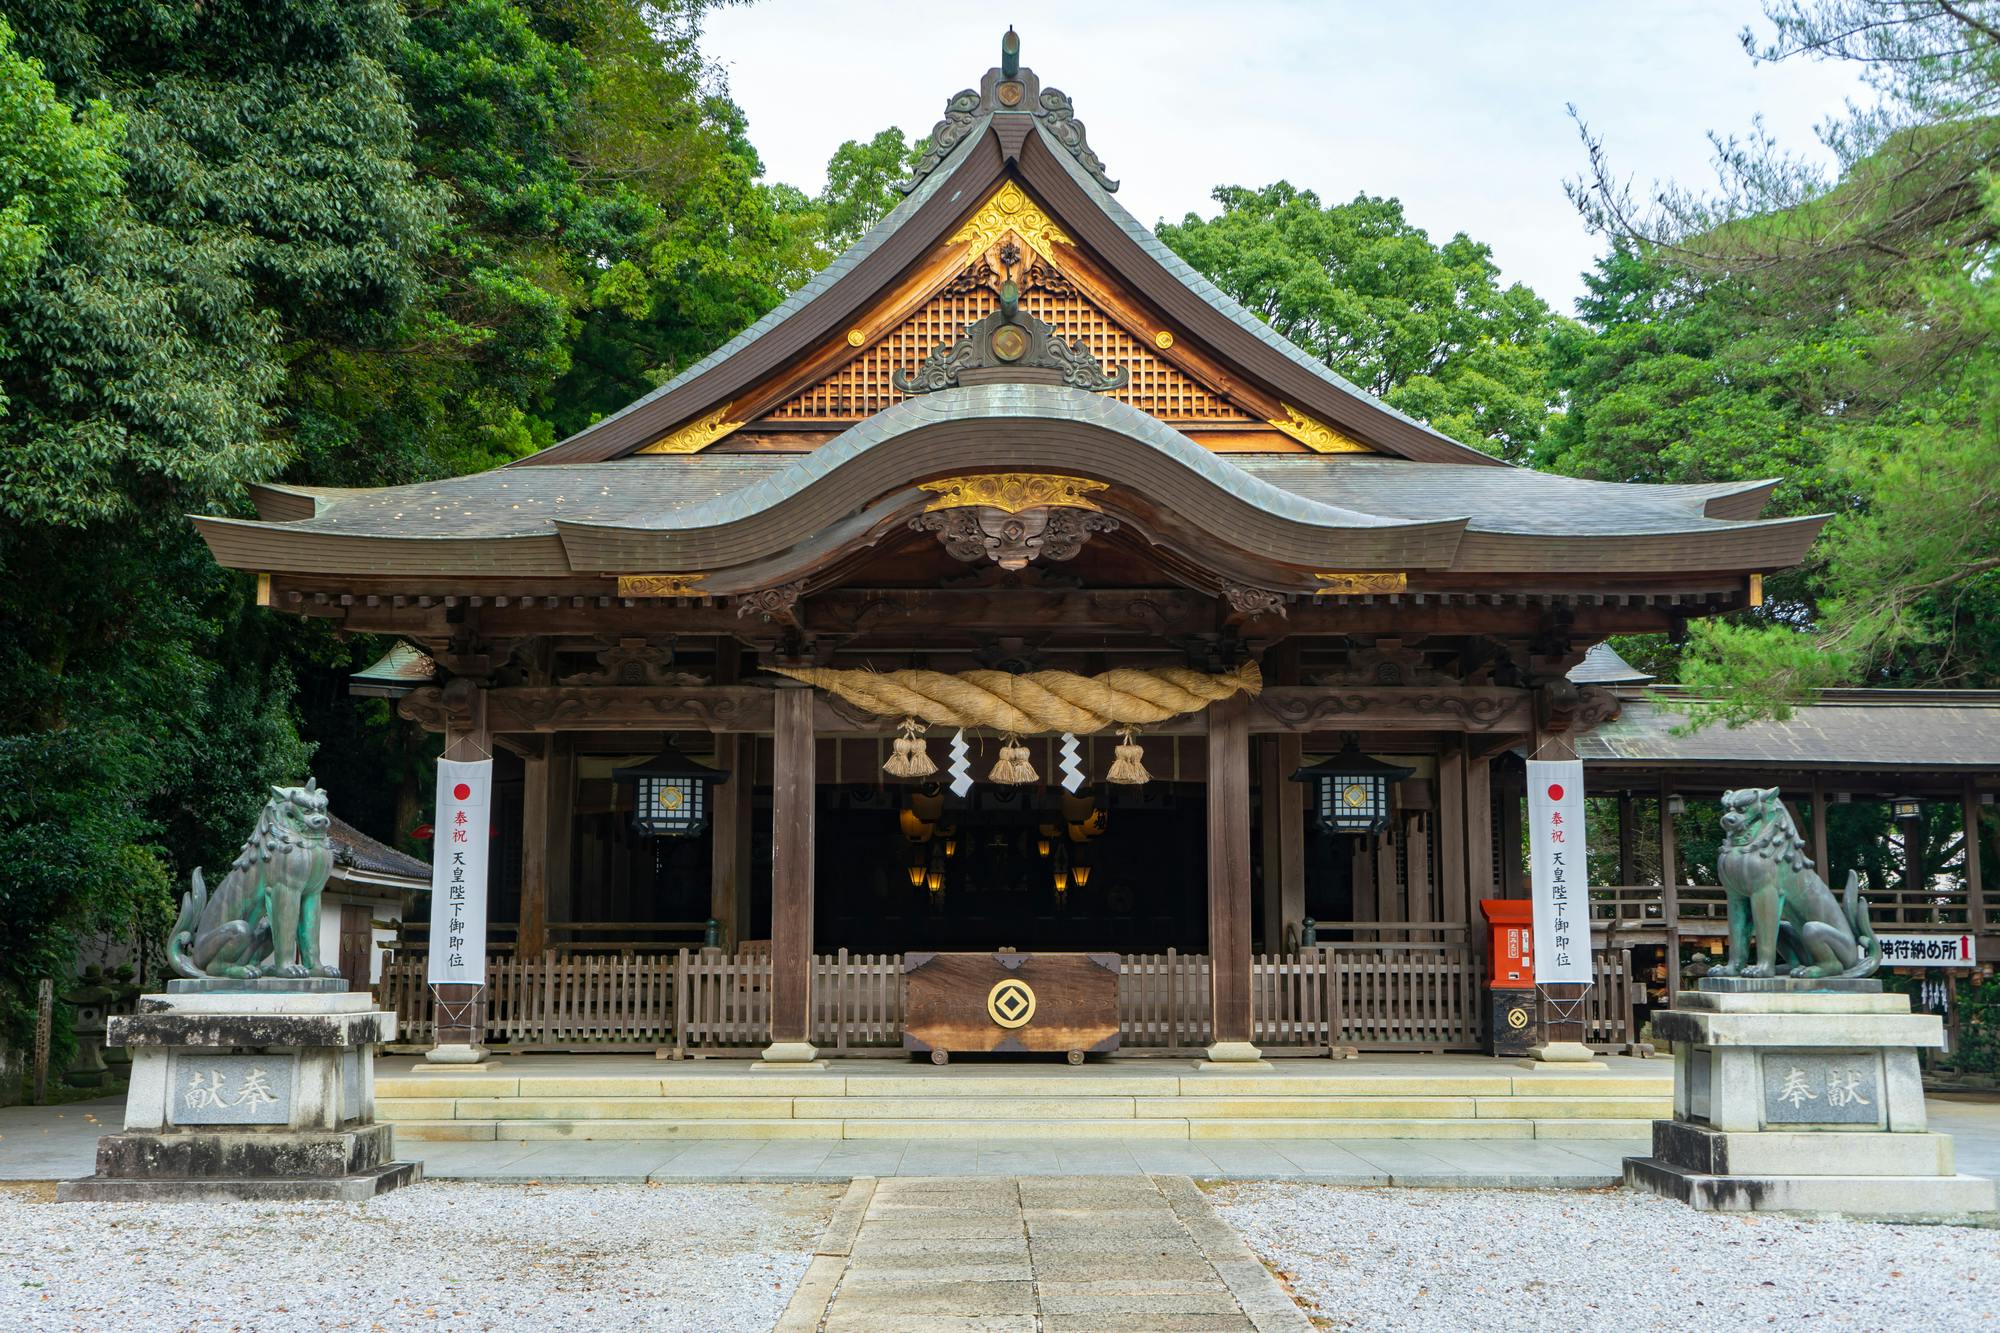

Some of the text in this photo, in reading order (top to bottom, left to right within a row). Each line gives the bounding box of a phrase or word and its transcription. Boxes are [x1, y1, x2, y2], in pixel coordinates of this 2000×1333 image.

[449, 810, 468, 968] 奉祝 天皇陛下御即位
[1551, 811, 1571, 967] 奉祝 天皇陛下御即位
[1864, 940, 1957, 960] 神符納め所
